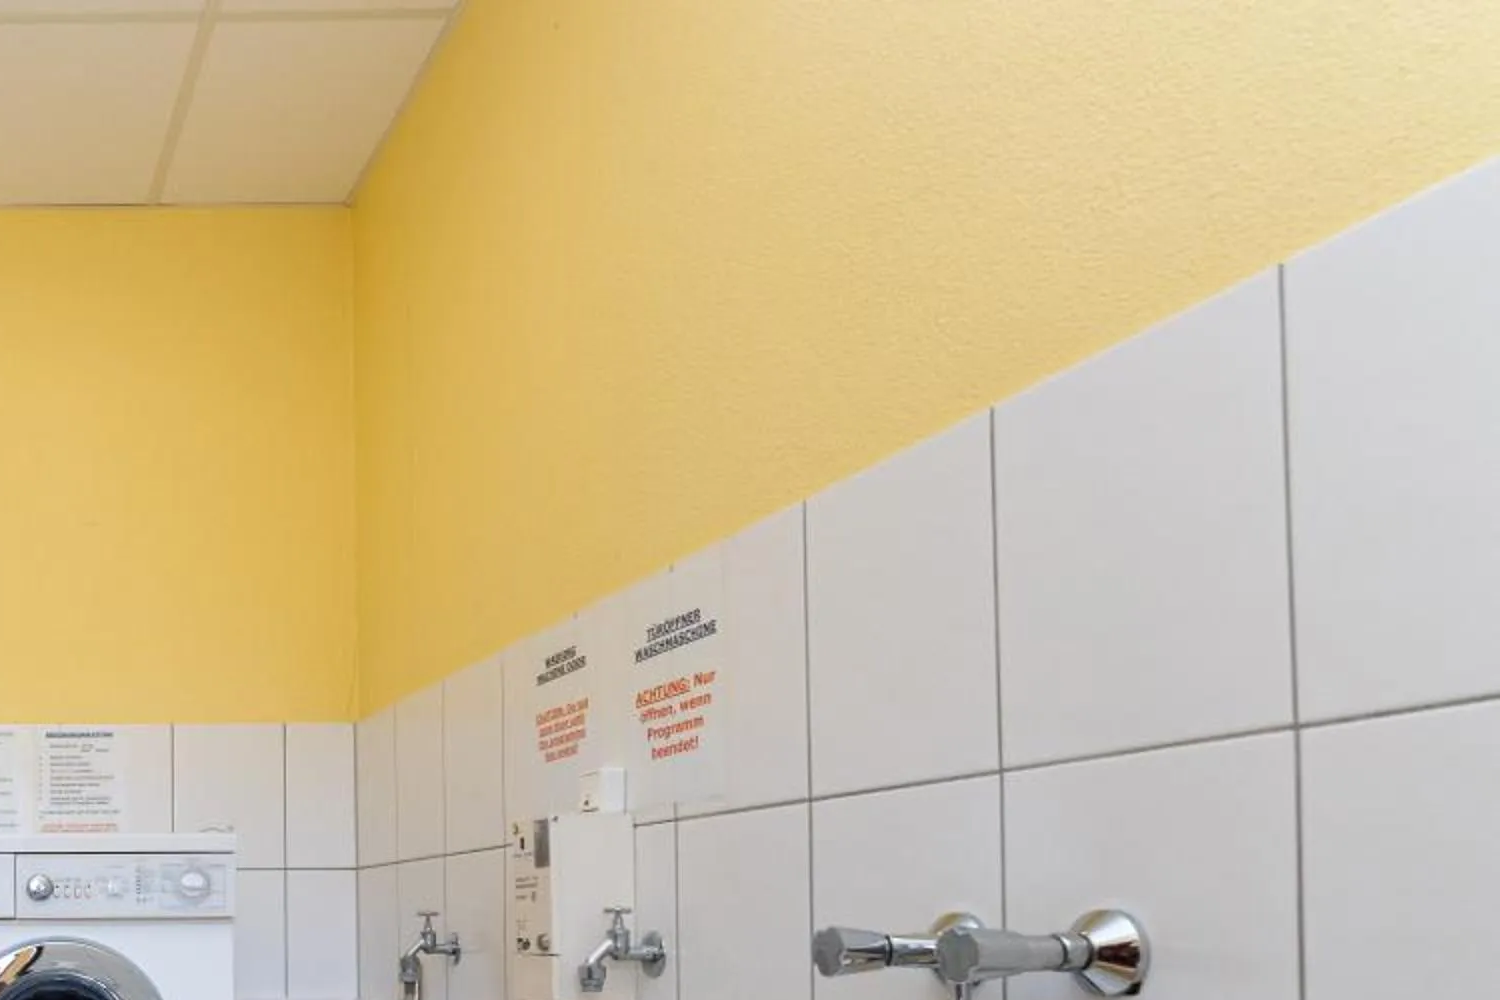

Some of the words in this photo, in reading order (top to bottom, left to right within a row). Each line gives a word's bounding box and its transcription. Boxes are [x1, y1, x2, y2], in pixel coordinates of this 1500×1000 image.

[634, 619, 717, 663] WASCHMASCHINE
[636, 677, 690, 708] ACHTUNG:
[694, 671, 716, 687] Nur
[680, 693, 712, 711] wenn
[647, 715, 705, 742] Programm
[651, 735, 699, 760] beendet!
